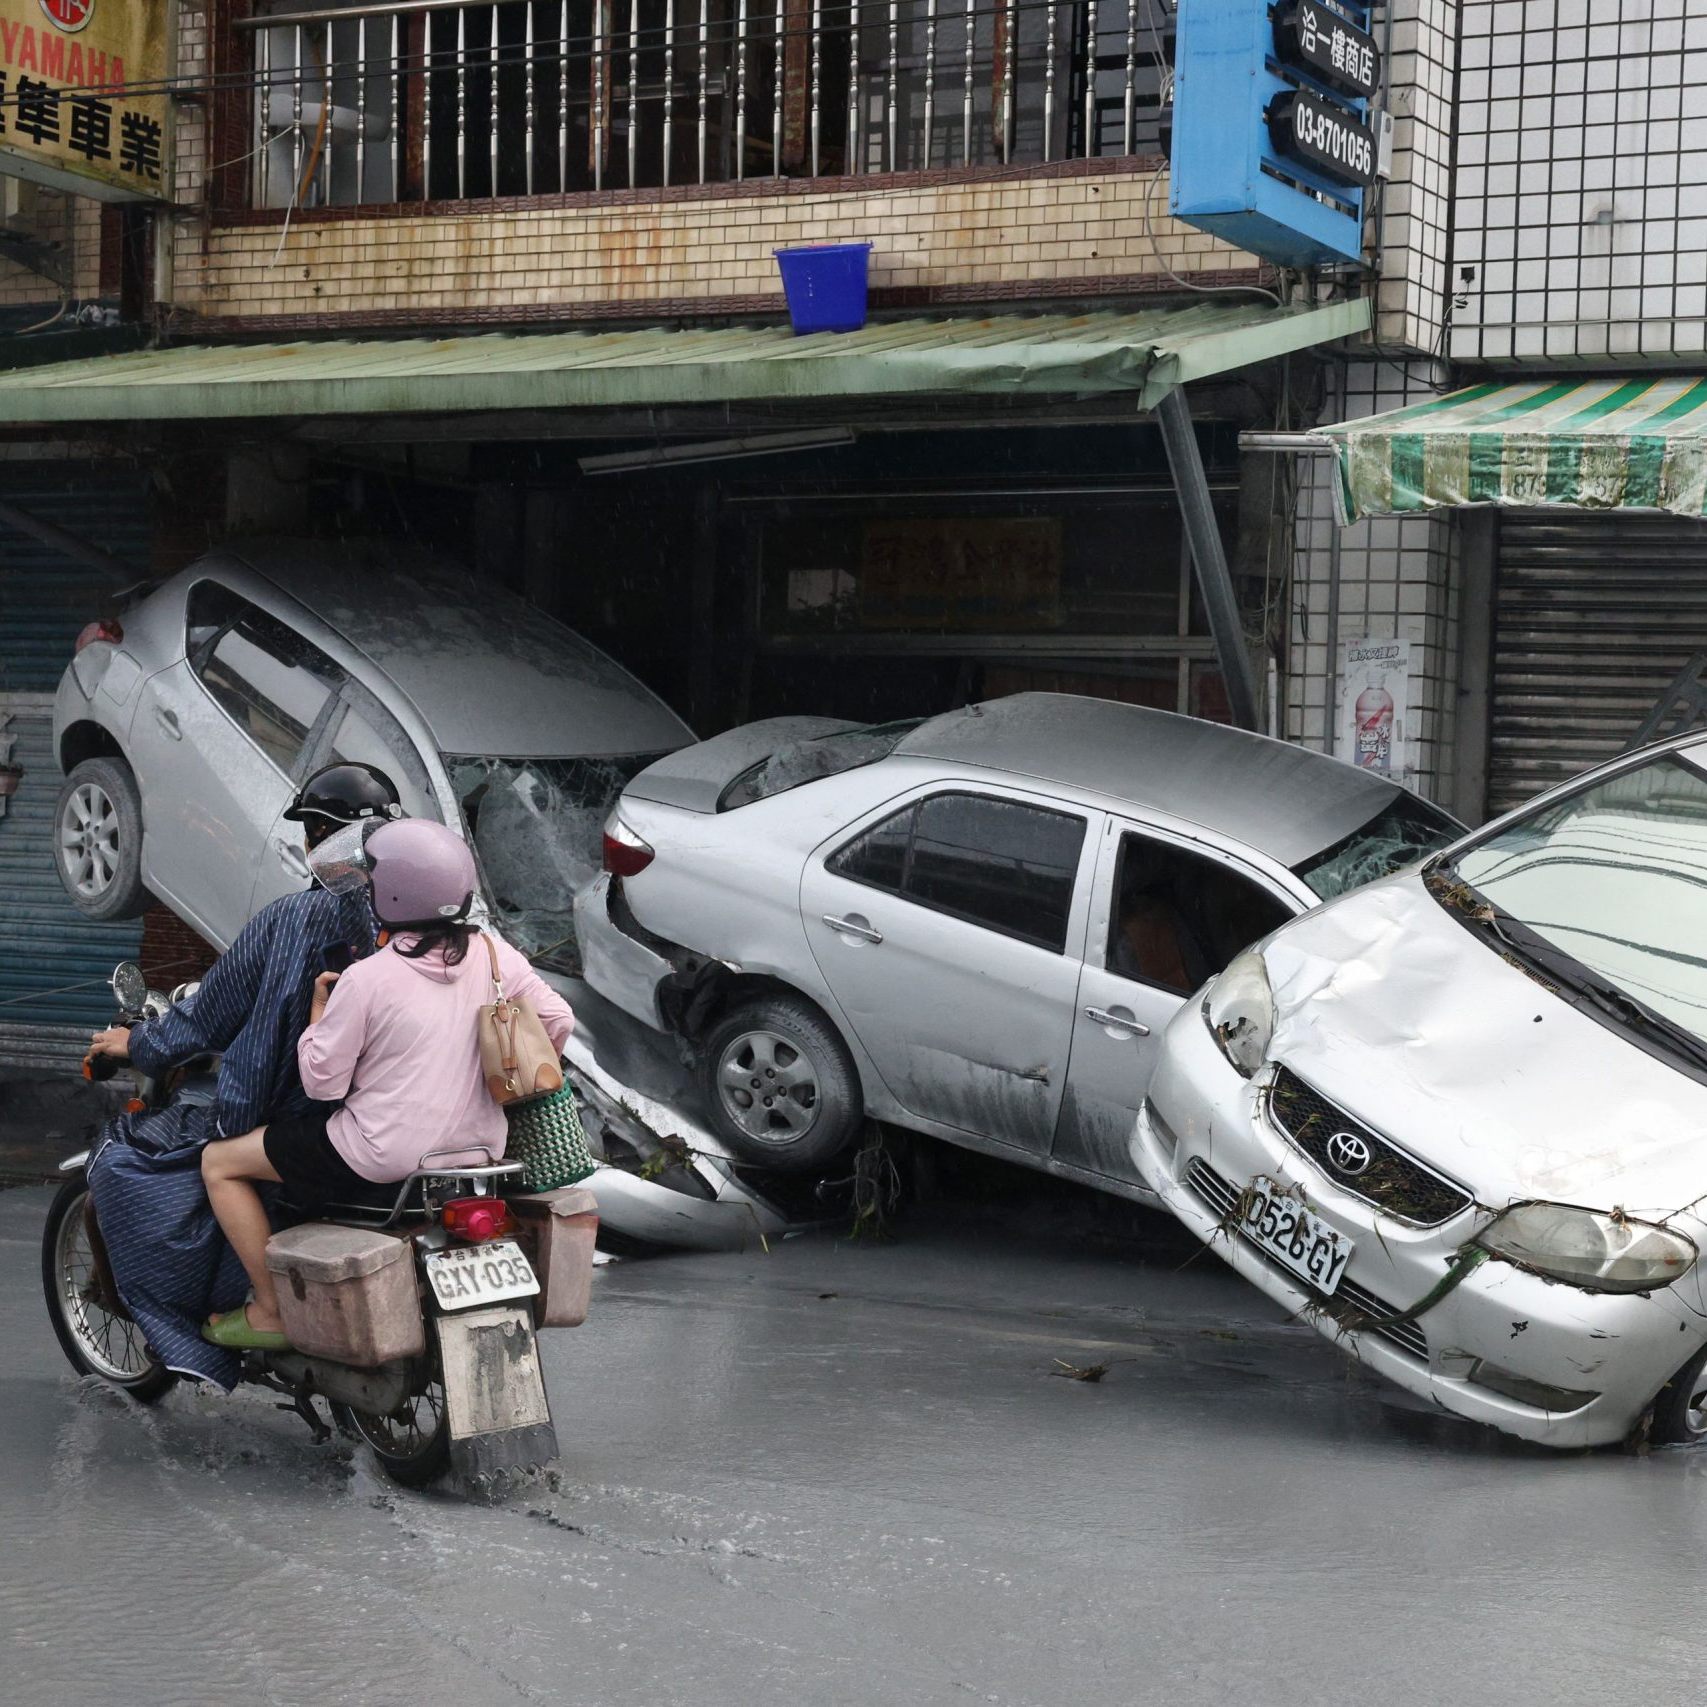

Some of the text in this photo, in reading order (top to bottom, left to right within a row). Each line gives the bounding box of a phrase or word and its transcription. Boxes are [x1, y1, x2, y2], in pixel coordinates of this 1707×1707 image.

[0, 17, 126, 102] YAMAHA
[1301, 5, 1374, 87] 洽一樓商店
[0, 71, 162, 180] 隼車業
[1296, 101, 1372, 176] 03-8701056
[434, 1257, 533, 1298] GXY-035
